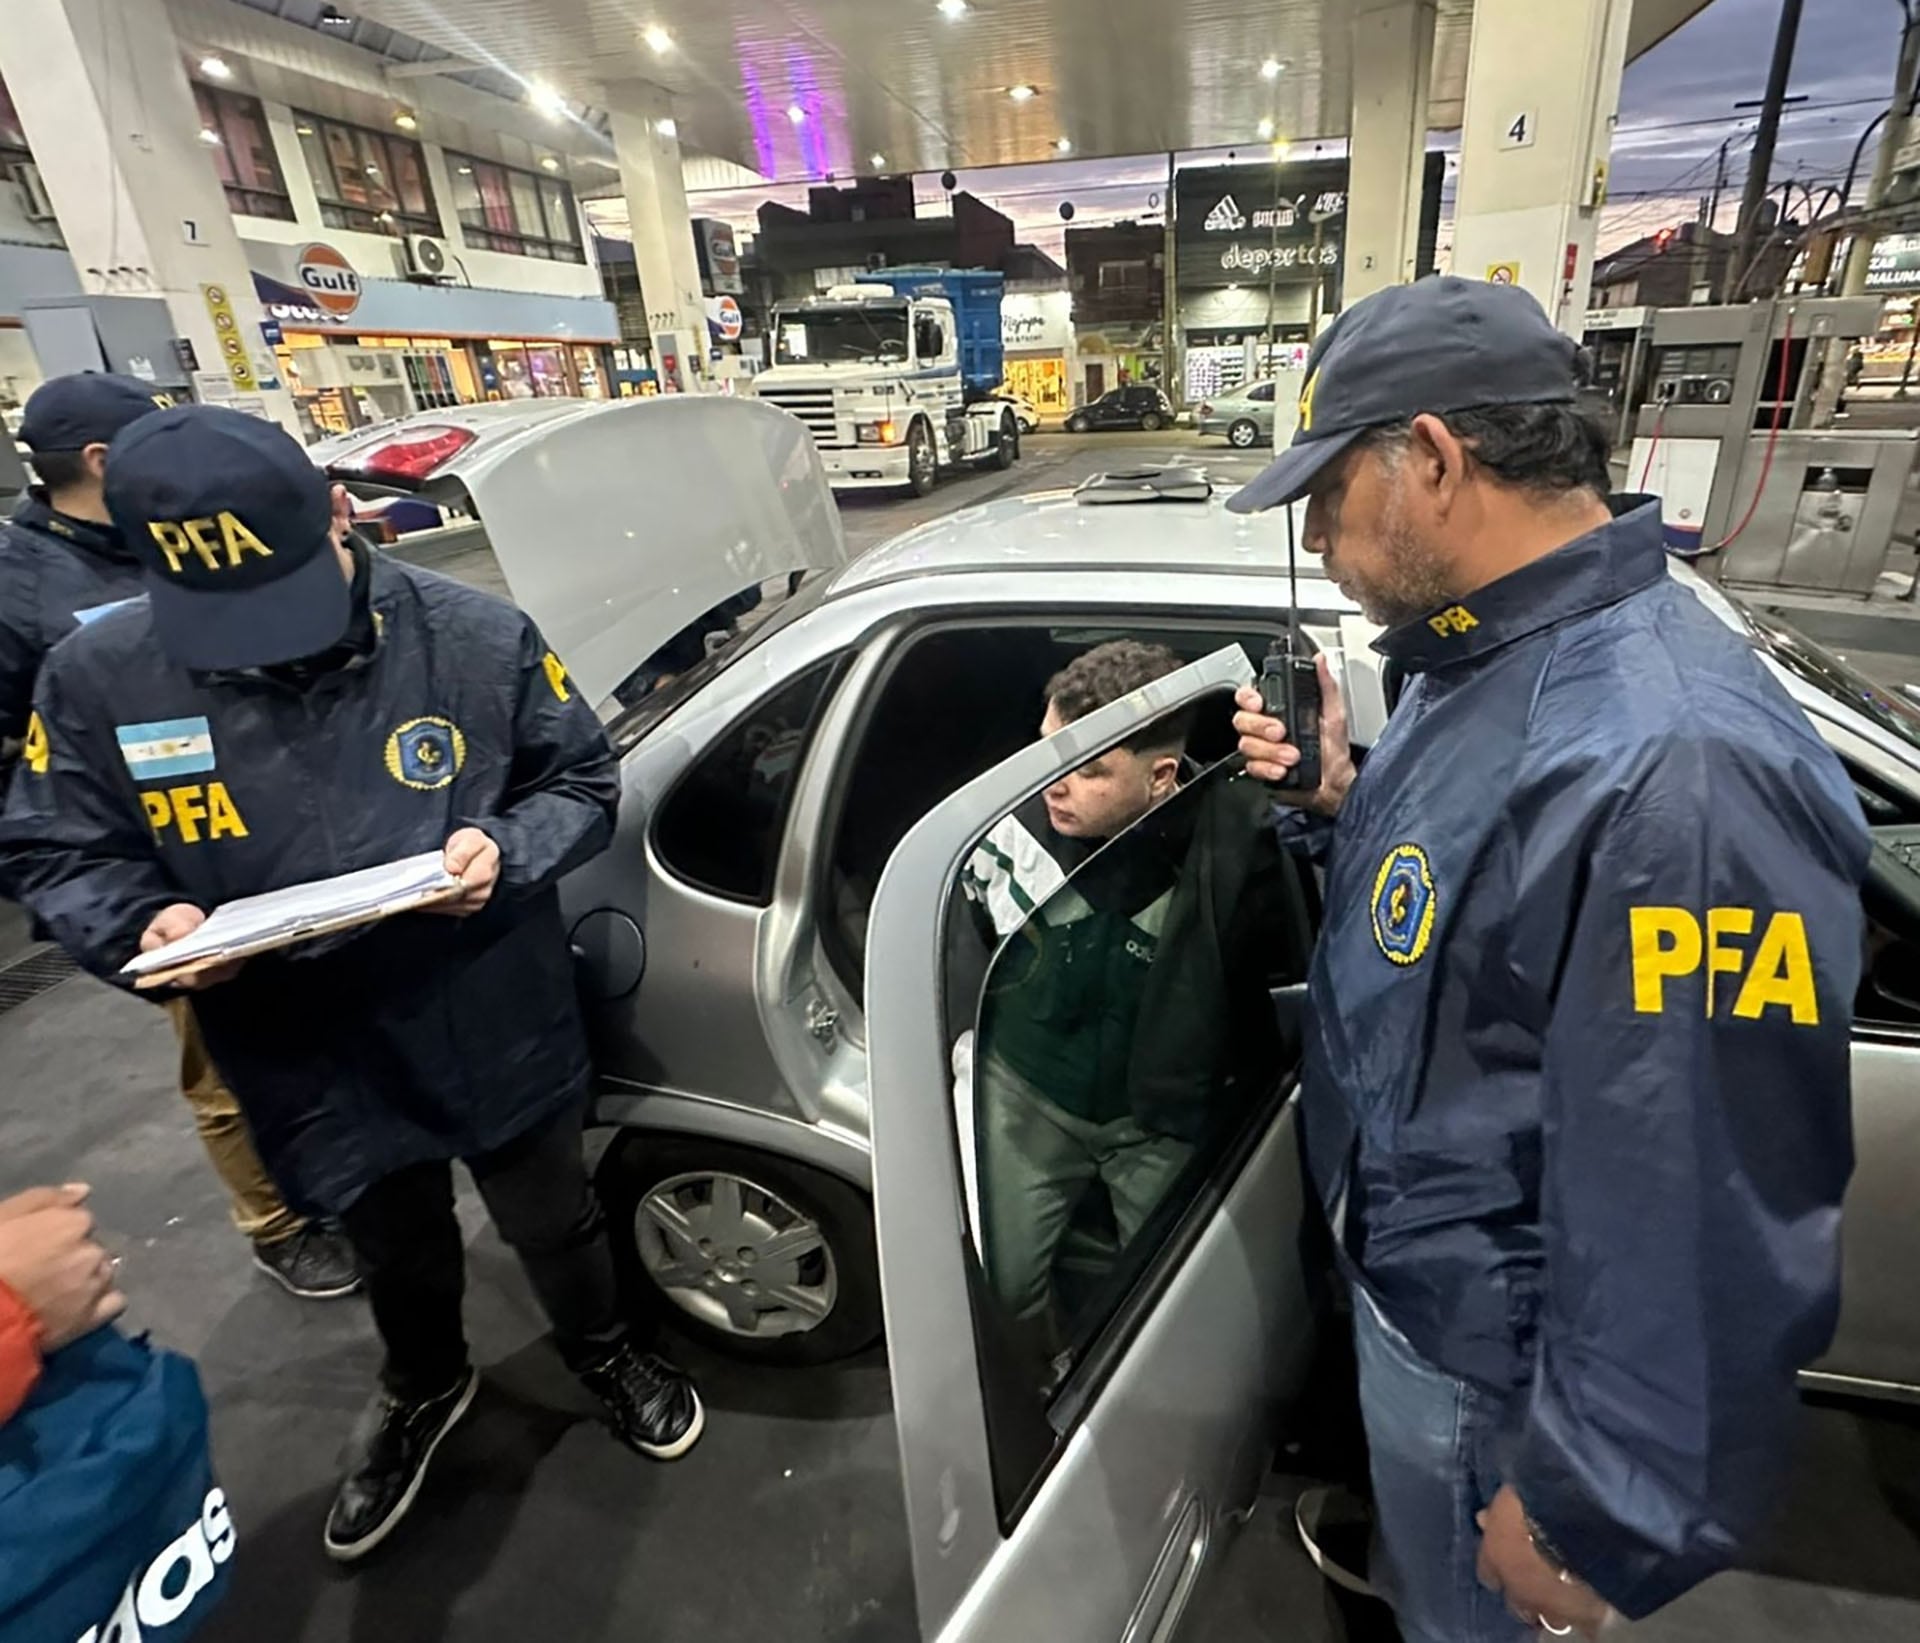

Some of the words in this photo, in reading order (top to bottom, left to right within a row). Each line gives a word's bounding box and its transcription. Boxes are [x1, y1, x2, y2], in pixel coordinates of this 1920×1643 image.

[1508, 113, 1526, 142] 4
[183, 220, 196, 241] 7
[301, 266, 358, 292] Gulf
[148, 511, 275, 573] PFA
[1427, 605, 1480, 638] PFA
[139, 781, 250, 848] PFA
[1629, 906, 1820, 1026] PFA
